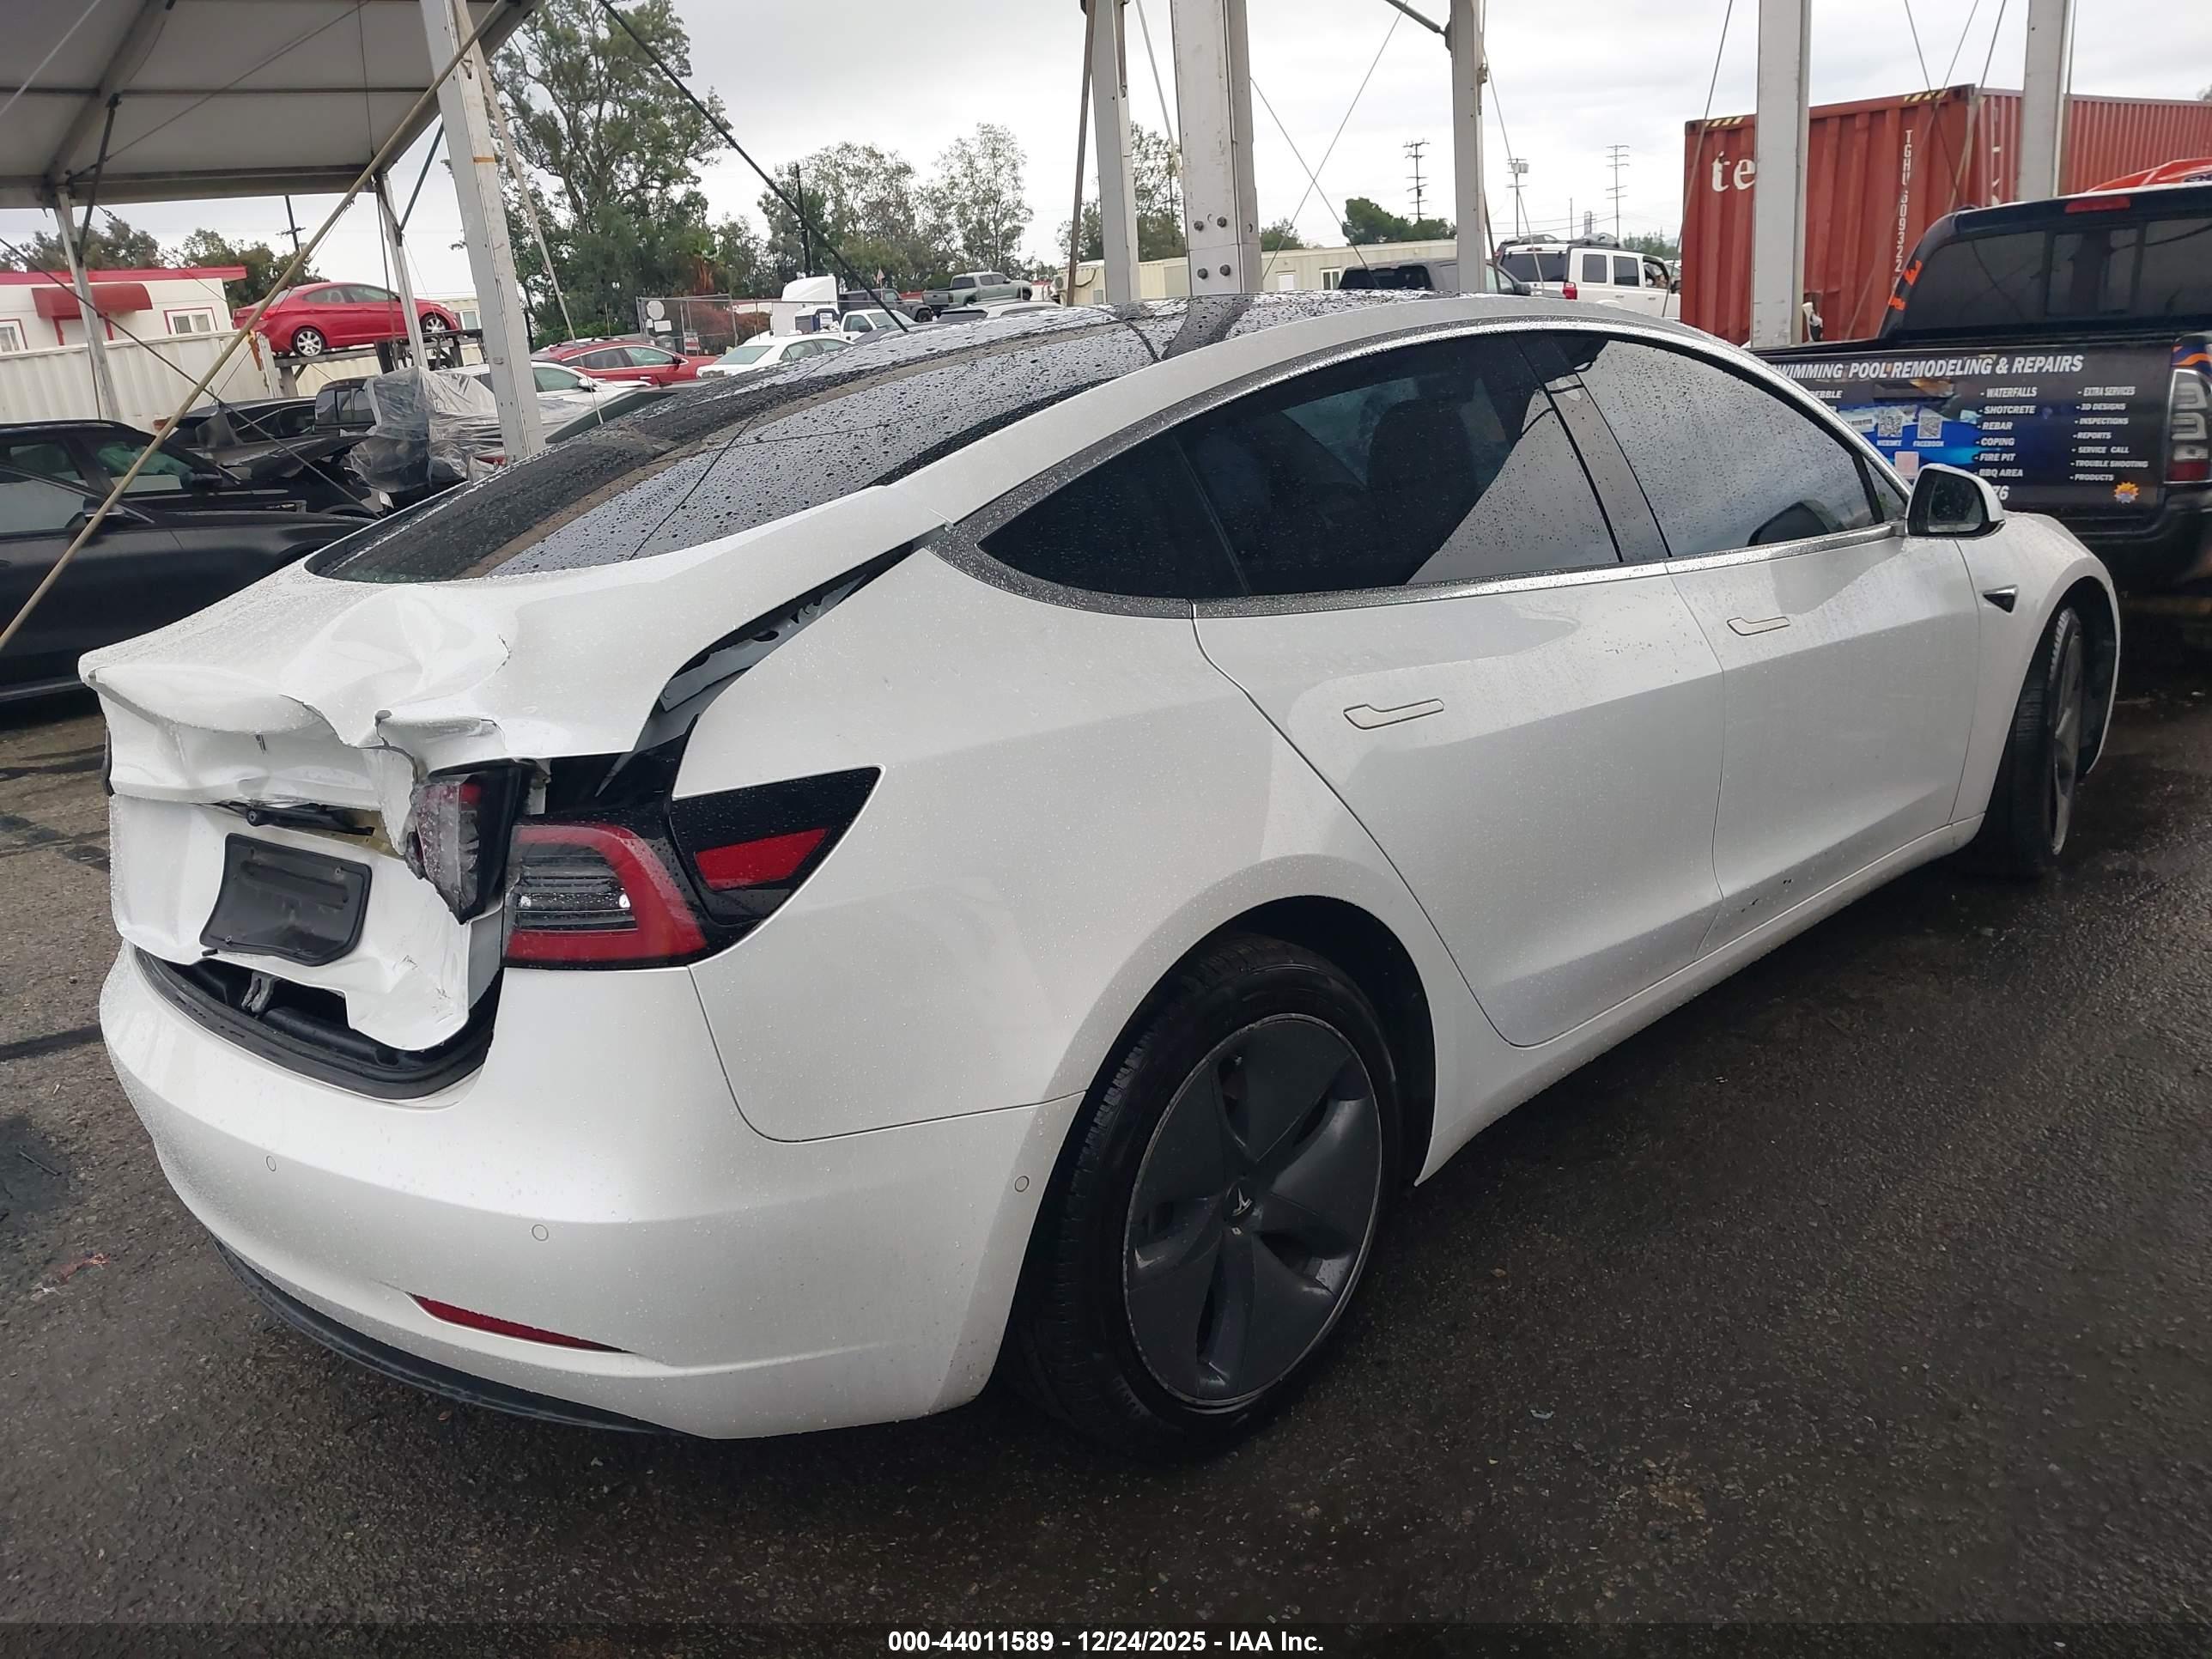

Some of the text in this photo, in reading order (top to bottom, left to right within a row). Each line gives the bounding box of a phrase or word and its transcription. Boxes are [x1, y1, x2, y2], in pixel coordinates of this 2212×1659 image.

[1848, 361, 1888, 379] POOL
[1889, 356, 1994, 379] REMODELING
[1995, 356, 2009, 374] &
[2011, 354, 2085, 374] REPAIRS
[1986, 386, 2038, 398] WATERFALLS
[1984, 404, 2036, 414] SHOTCRETE
[1982, 422, 2013, 430] REBAR
[1980, 437, 2015, 446] COPING
[1978, 453, 2016, 462] FIRE PIT
[1998, 468, 2023, 477] AREA
